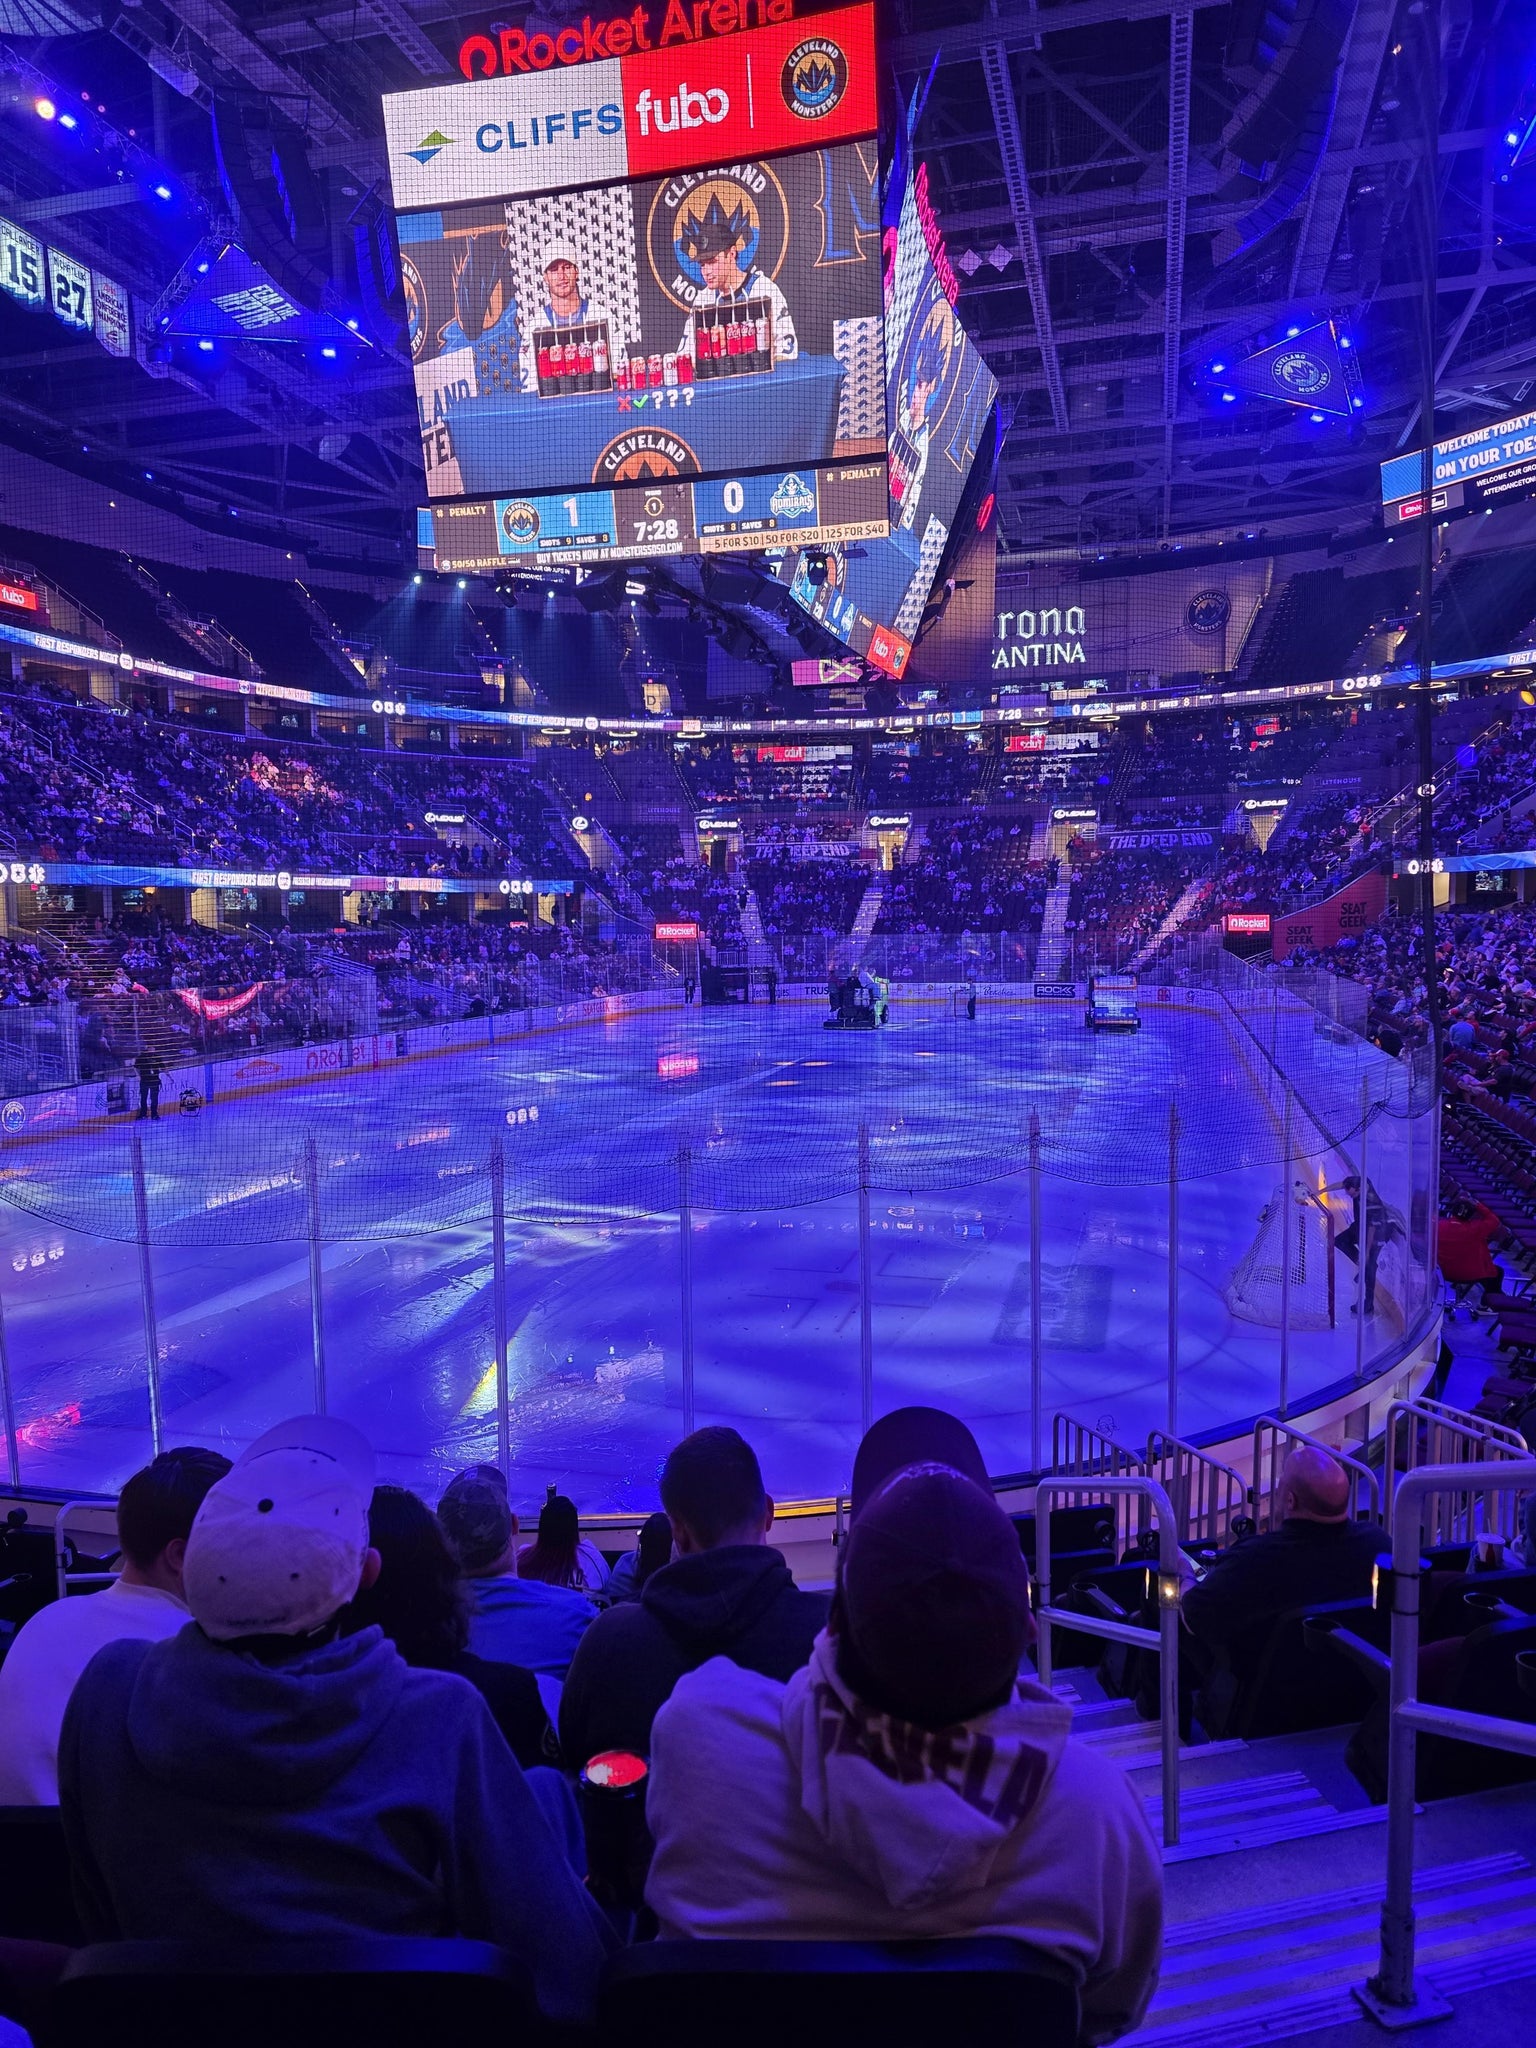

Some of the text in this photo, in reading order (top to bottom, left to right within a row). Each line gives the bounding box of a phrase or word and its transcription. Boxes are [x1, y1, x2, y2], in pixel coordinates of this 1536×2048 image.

[502, 5, 652, 75] Rocket
[787, 41, 839, 68] CLEVELAND
[636, 82, 730, 136] fubo
[791, 92, 838, 117] MONSTERS
[475, 103, 624, 153] CLIFFS
[7, 243, 38, 294] 15
[56, 273, 85, 321] 27
[1275, 353, 1306, 376] CLEVELAND
[1298, 372, 1328, 393] MONSTERS
[604, 434, 686, 470] CLEVELAND
[1437, 430, 1491, 455] WELCOME
[1436, 460, 1457, 479] ON
[1458, 447, 1501, 472] YOUR
[840, 467, 882, 481] PENALTY
[1476, 472, 1508, 487] WELCOME
[1508, 468, 1522, 478] OUR
[723, 481, 744, 514] 0
[771, 493, 814, 513] ADMIRALS
[449, 505, 487, 518] PENALTY
[506, 502, 535, 516] CLEVELAND
[562, 496, 579, 527] 1
[633, 518, 679, 542] 7:28
[769, 519, 775, 528] 8
[565, 537, 572, 545] 9
[715, 524, 884, 548] 5 FOR $10 50 FOR $20 125 FOR $40
[452, 558, 476, 569] 50/50
[476, 556, 507, 567] RAFFLE
[536, 553, 550, 564] BUY
[552, 552, 582, 563] TICKETS
[583, 550, 600, 561] NOW
[600, 549, 610, 559] AT
[2, 586, 25, 605] fubo
[993, 605, 1087, 640] rona
[35, 635, 57, 649] FIRST
[56, 641, 99, 660] RESPONDERS
[992, 641, 1087, 669] ANTINA
[1508, 652, 1531, 665] FIRST
[1294, 686, 1310, 695] 8:01
[1312, 684, 1323, 692] PM
[508, 713, 527, 724] FIRST
[998, 708, 1022, 720] 7:28
[1140, 701, 1147, 710] 8
[1183, 697, 1190, 707] 8
[1109, 831, 1213, 850] THE DEEP END
[192, 872, 213, 885] FIRST
[213, 873, 257, 886] RESPONDERS
[1340, 902, 1368, 915] SEAT
[666, 926, 695, 936] Rocket
[1238, 918, 1267, 928] Rocket
[1287, 926, 1313, 935] SEAT
[1339, 915, 1368, 928] GEEK
[1285, 935, 1314, 945] GEEK
